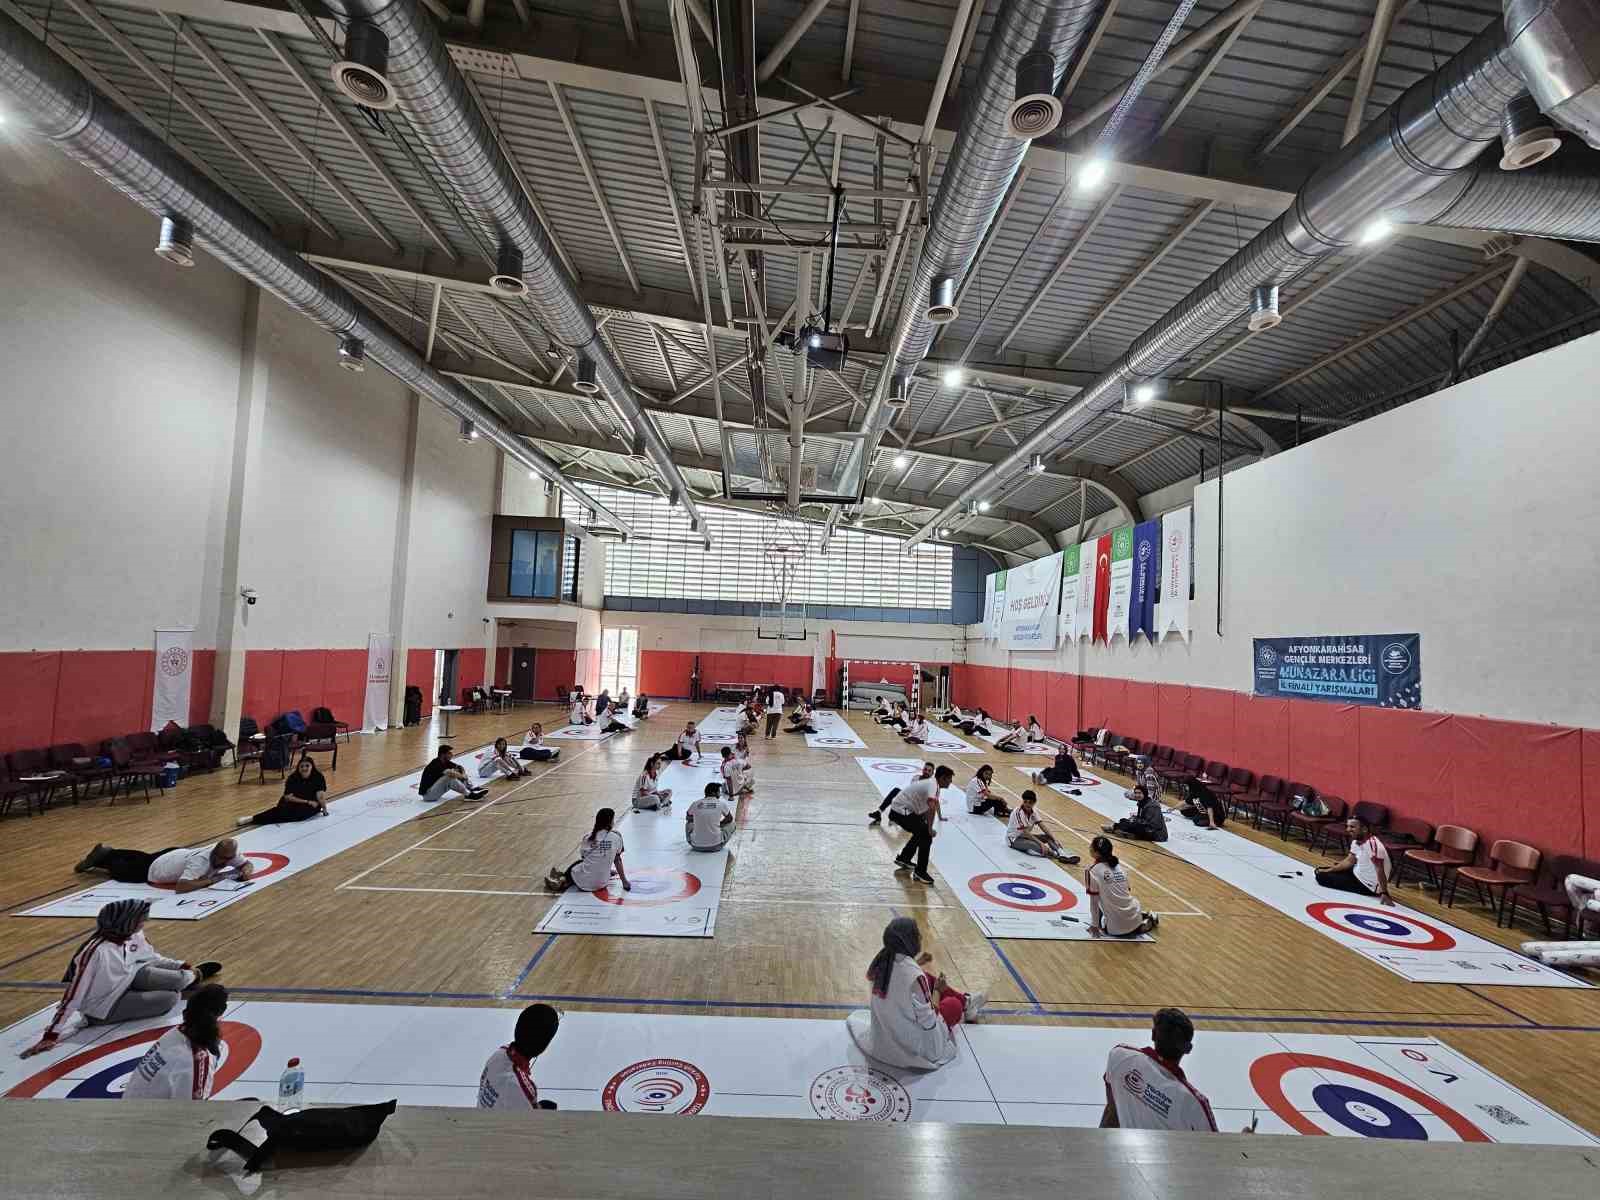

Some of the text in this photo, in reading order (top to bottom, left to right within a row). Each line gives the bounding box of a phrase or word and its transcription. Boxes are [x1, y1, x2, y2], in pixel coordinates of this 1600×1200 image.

[1288, 643, 1364, 654] AFYONKARAHİSAR
[1284, 654, 1316, 665] GENÇLİK
[1318, 654, 1371, 665] MERKEZLERİ
